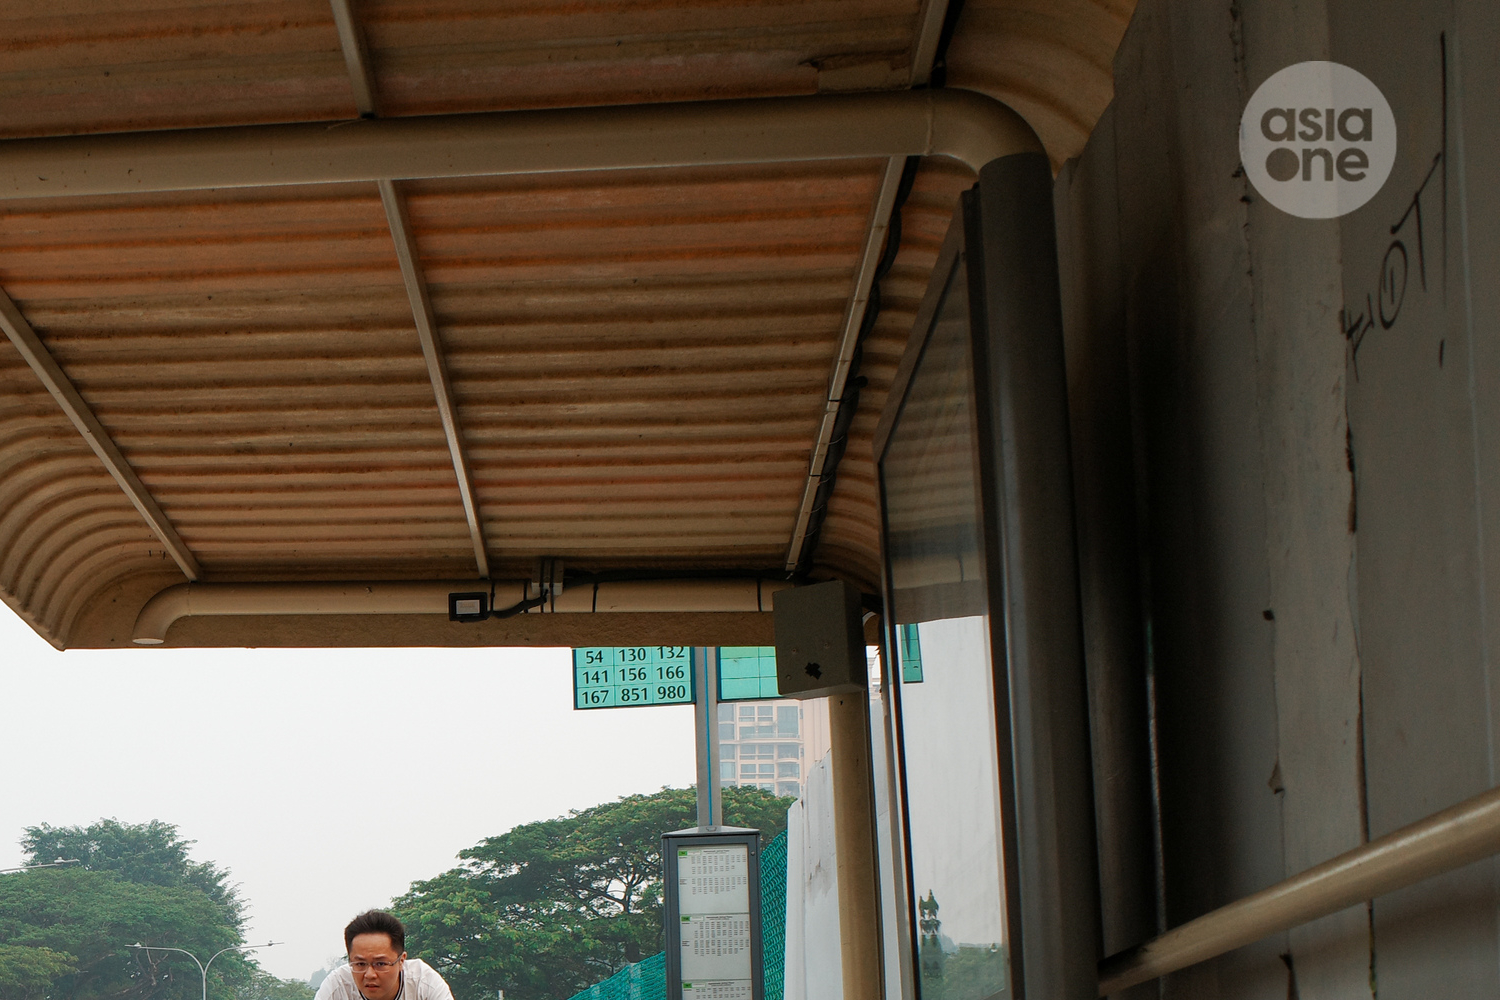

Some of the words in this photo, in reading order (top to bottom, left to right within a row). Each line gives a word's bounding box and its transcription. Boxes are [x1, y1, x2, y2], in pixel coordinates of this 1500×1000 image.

[585, 650, 603, 664] 54
[619, 648, 646, 662] 130
[657, 646, 685, 659] 132
[582, 670, 608, 684] 141
[619, 667, 646, 681] 156
[656, 666, 684, 680] 166
[582, 690, 609, 704] 167
[621, 688, 647, 701] 851
[657, 685, 685, 699] 980
